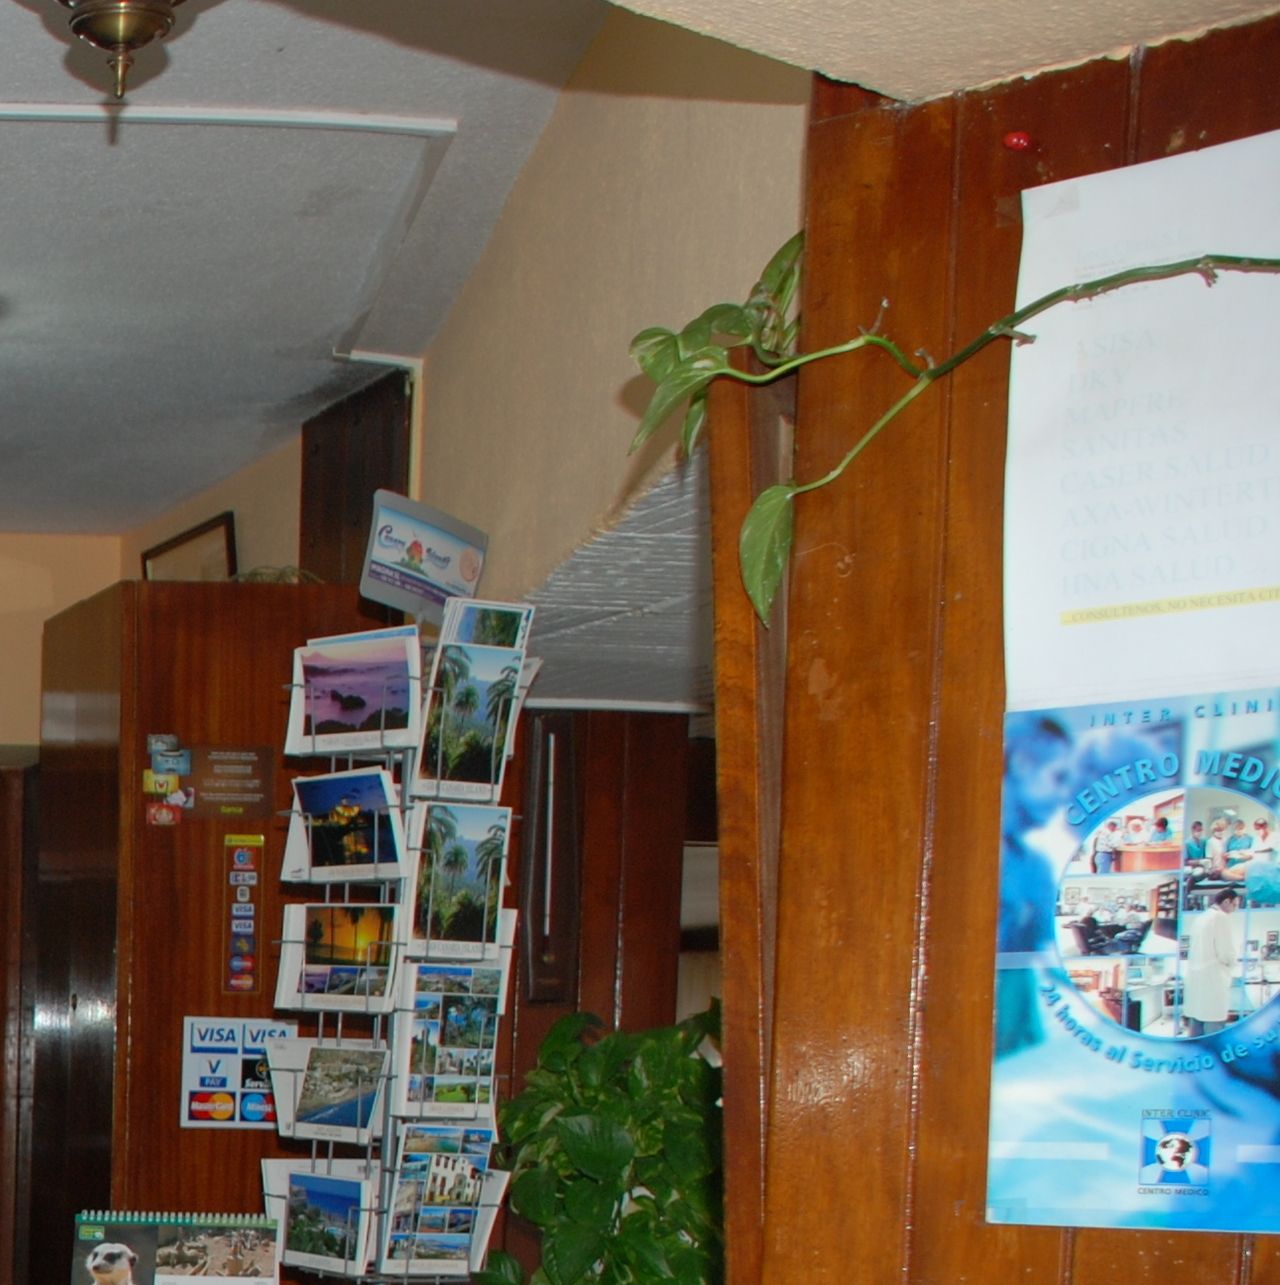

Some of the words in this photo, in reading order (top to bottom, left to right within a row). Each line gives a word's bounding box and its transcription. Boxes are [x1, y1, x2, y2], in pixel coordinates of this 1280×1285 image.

[1062, 420, 1188, 463] SANITAS
[1060, 461, 1153, 494] CASER
[1165, 443, 1269, 477] SALUD
[1060, 531, 1153, 561] CIGNA
[1161, 515, 1269, 549] SALUD
[1130, 554, 1236, 585] SALUD
[1090, 708, 1171, 728] INTER
[1195, 699, 1272, 718] CLINI
[1066, 751, 1180, 827] CENTRO
[197, 1028, 236, 1042] VISA
[1055, 1005, 1103, 1052] horas
[1105, 1045, 1126, 1063] al
[1130, 1051, 1215, 1074] Servicio
[1221, 1042, 1249, 1063] de
[204, 1077, 222, 1086] PAY
[208, 1059, 221, 1074] V
[1137, 1187, 1171, 1195] CENTRO
[1175, 1187, 1209, 1196] MEDICO
